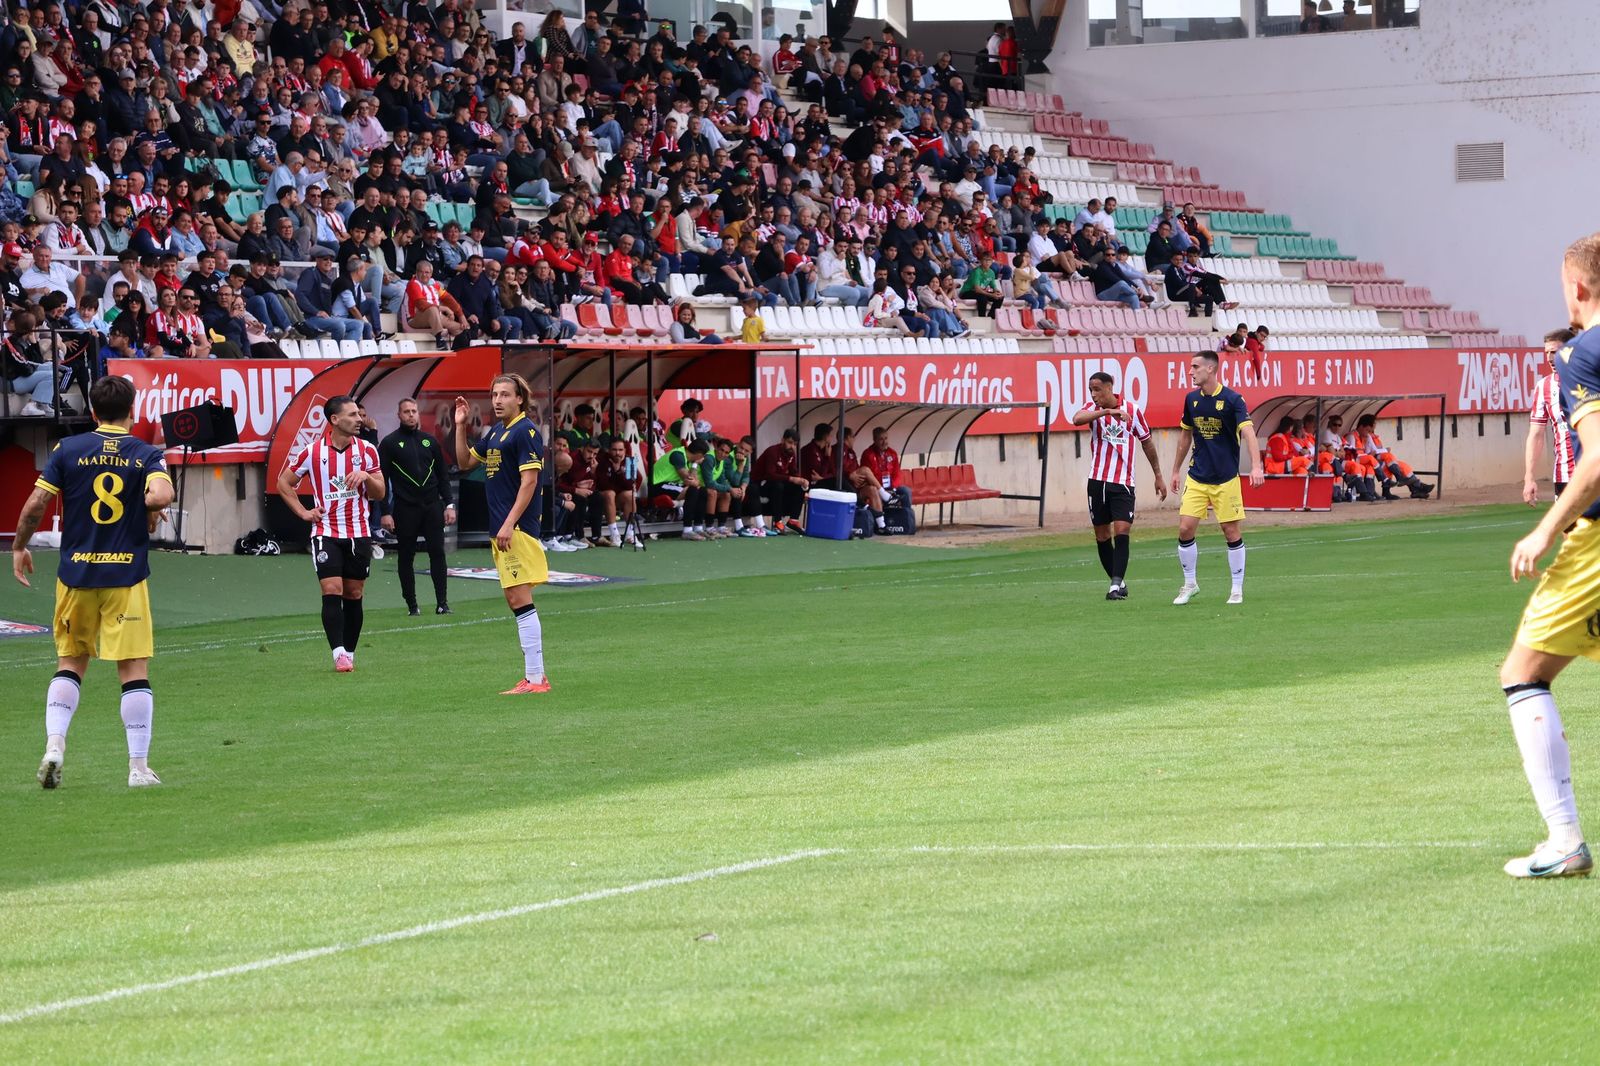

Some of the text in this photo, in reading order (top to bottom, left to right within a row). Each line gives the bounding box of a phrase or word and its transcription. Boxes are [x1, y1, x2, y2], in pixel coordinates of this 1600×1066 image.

[811, 357, 907, 399] RÓTULOS
[919, 361, 1013, 413] Gráficas
[1167, 353, 1374, 389] FACACIÓN DE STAND
[1457, 352, 1524, 411] ZAMORA
[77, 454, 129, 467] MARTÍN
[90, 471, 124, 525] 8
